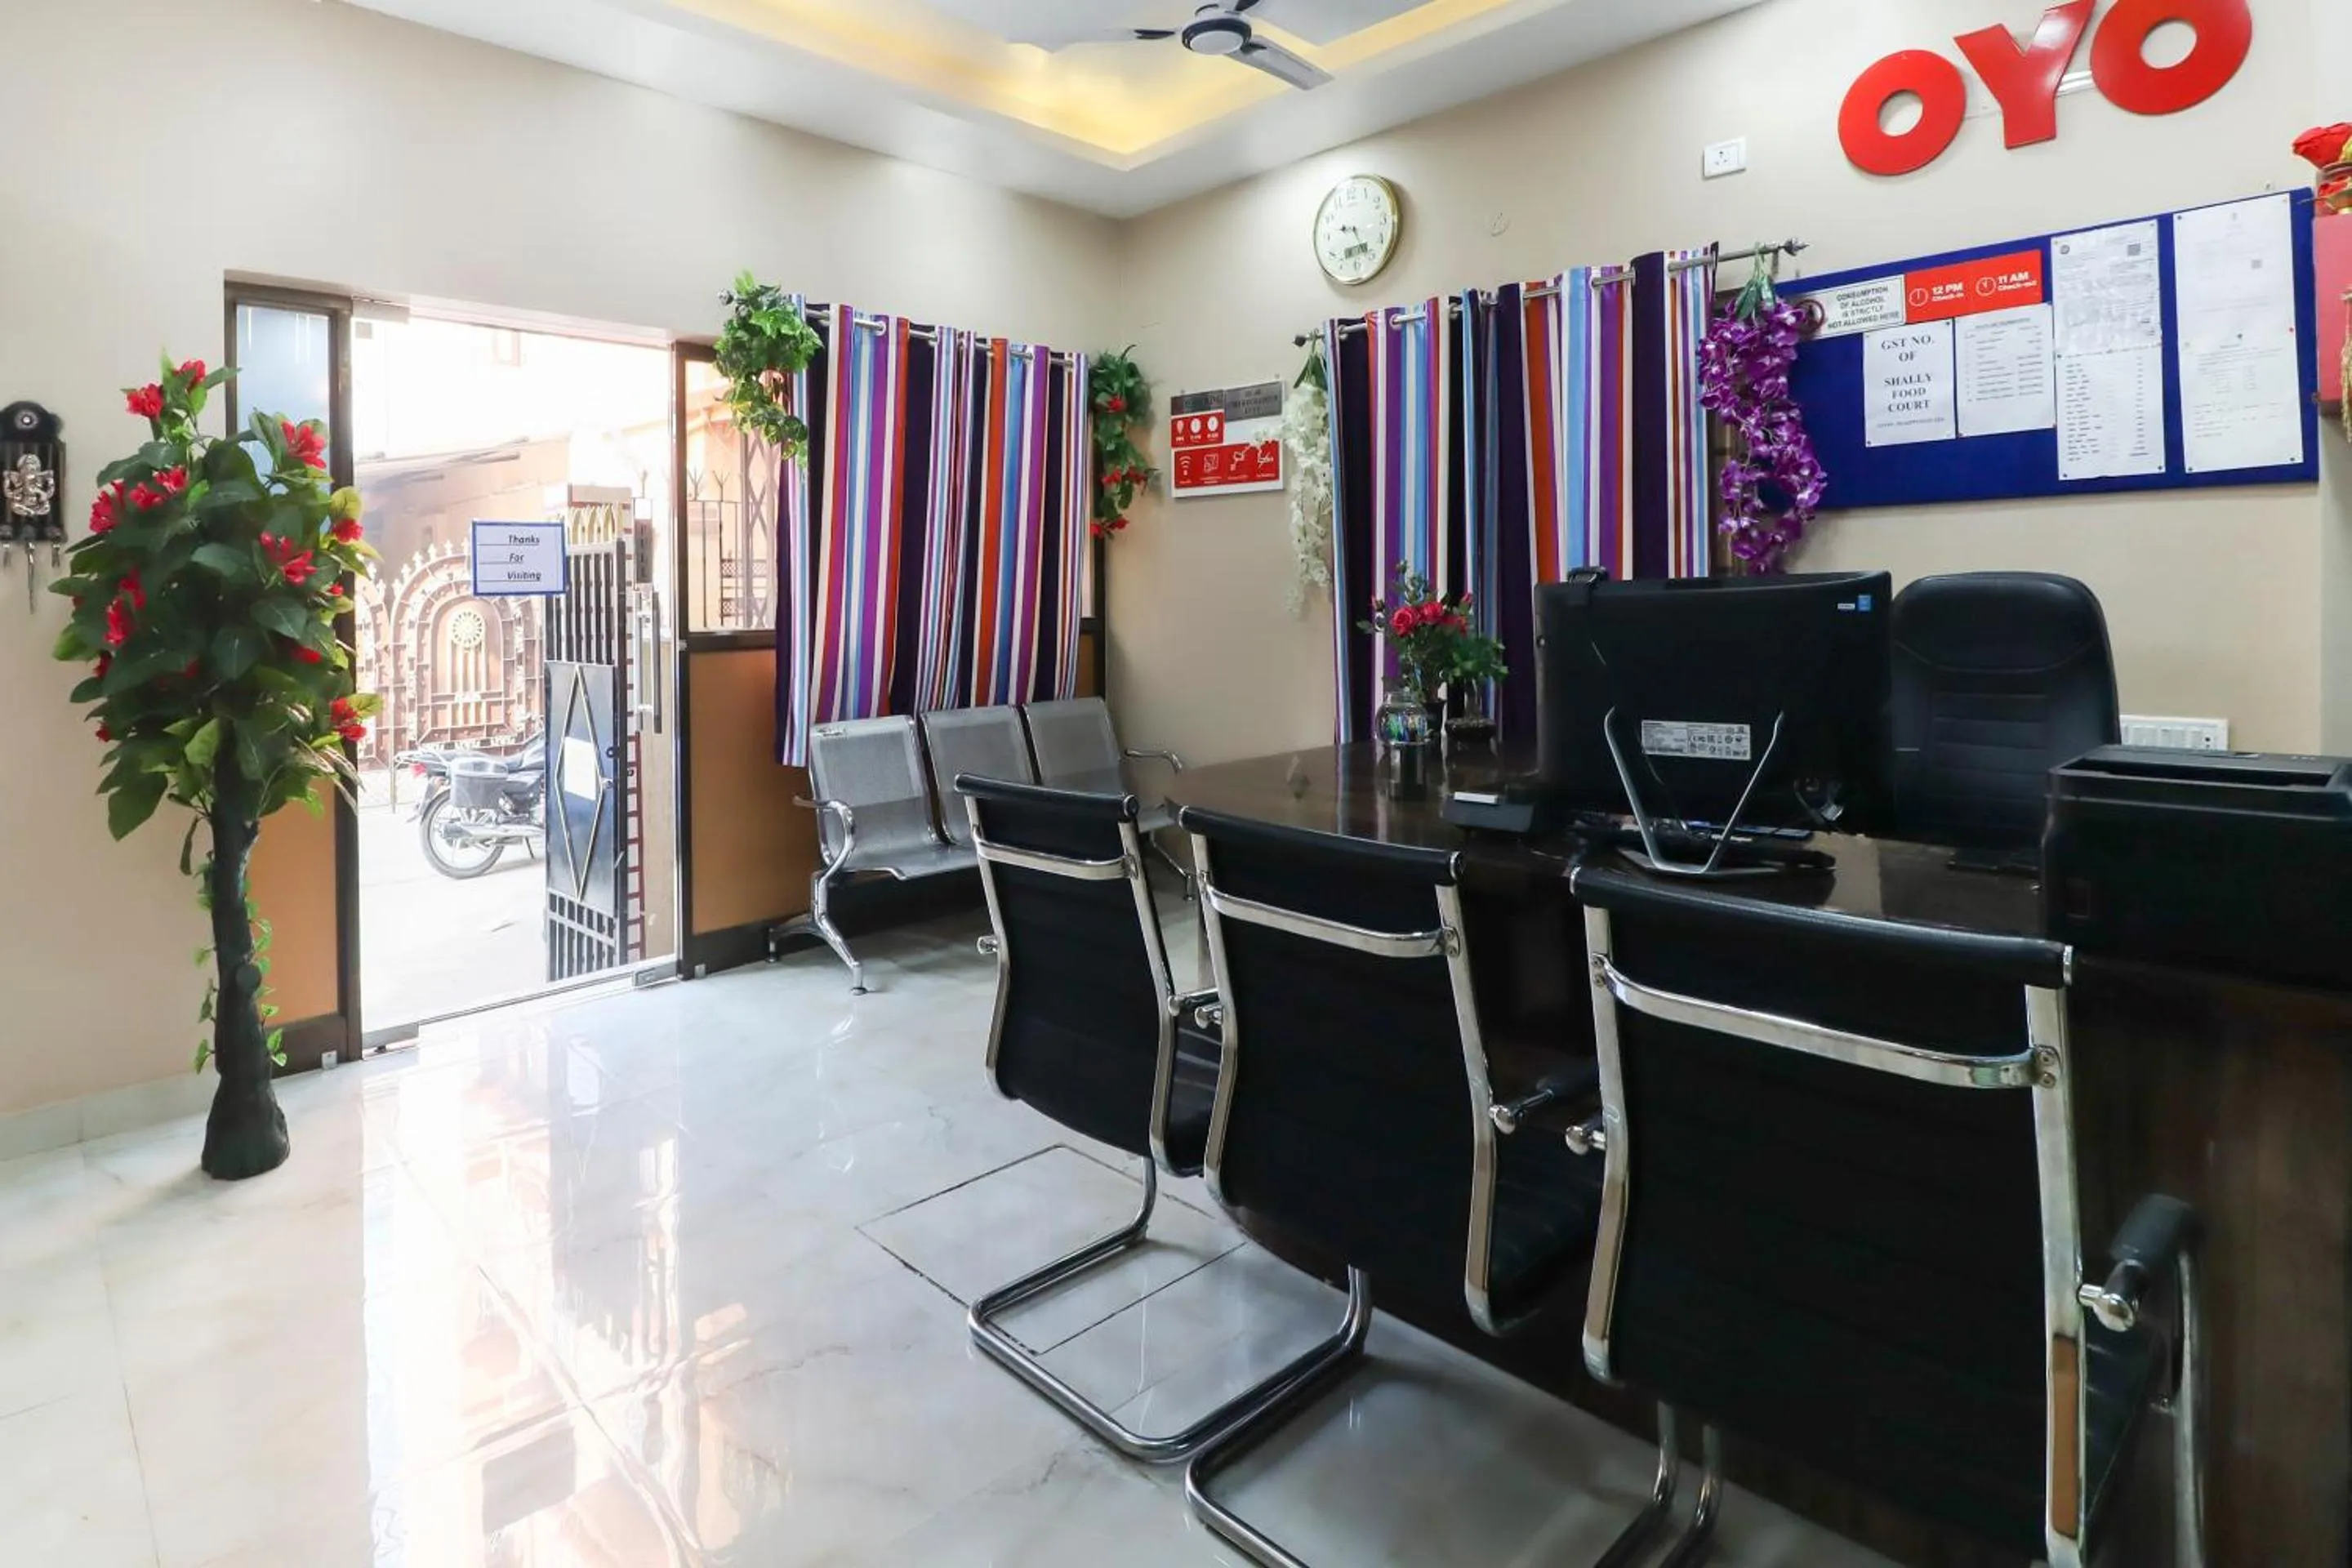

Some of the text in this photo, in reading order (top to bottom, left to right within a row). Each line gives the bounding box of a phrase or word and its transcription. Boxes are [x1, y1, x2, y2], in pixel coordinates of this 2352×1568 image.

[1838, 0, 2252, 176] OYO
[1998, 271, 2029, 284] 11 AM
[1836, 284, 1889, 301] CONSUMPTION
[1932, 282, 1963, 296] 12 PM
[1840, 296, 1886, 310] OF ALCOHOL
[1851, 305, 1883, 316] STRICTLY
[1828, 310, 1900, 329] NOT ALLOWED HERE
[1881, 338, 1907, 350] GST
[1899, 351, 1917, 362] OF
[1884, 372, 1932, 386] SHALLY
[1892, 387, 1927, 399] FOOD
[1888, 399, 1931, 412] COURT
[509, 534, 540, 543] Thanks
[510, 553, 524, 562] For
[507, 571, 541, 581] Visiting
